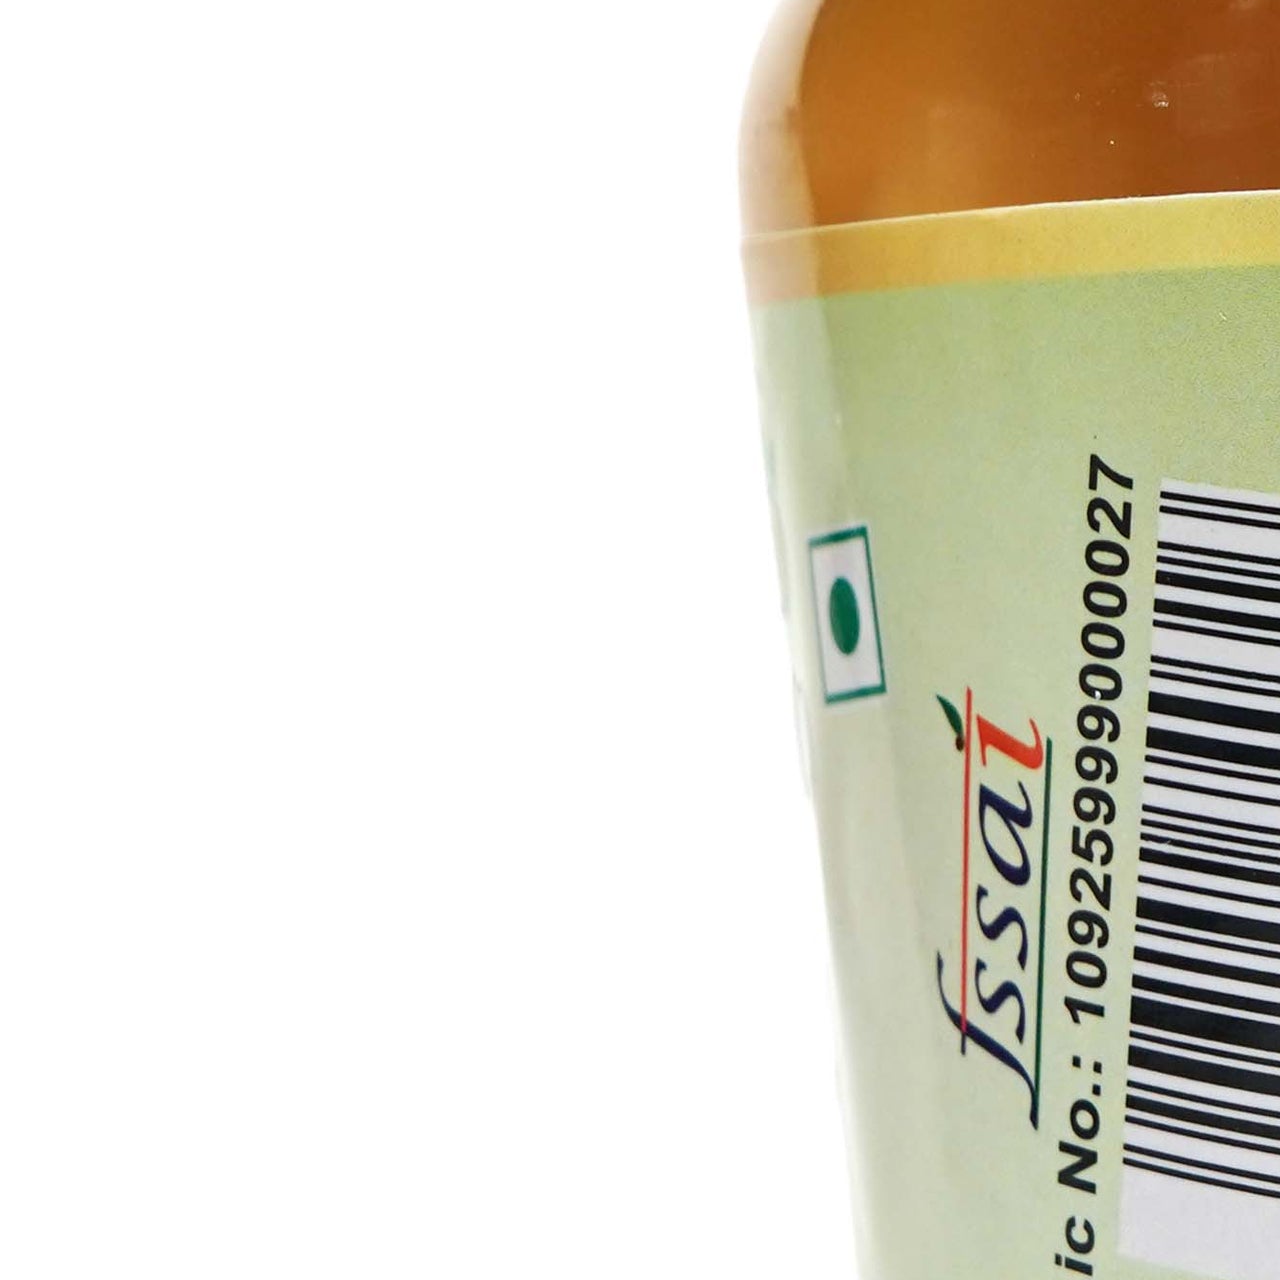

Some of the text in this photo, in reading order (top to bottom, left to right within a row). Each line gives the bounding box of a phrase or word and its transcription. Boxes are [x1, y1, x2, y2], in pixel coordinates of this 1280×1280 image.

[935, 692, 1045, 1130] fssai
[1063, 453, 1134, 1024] 10925999000027
[1057, 1061, 1102, 1195] No.:
